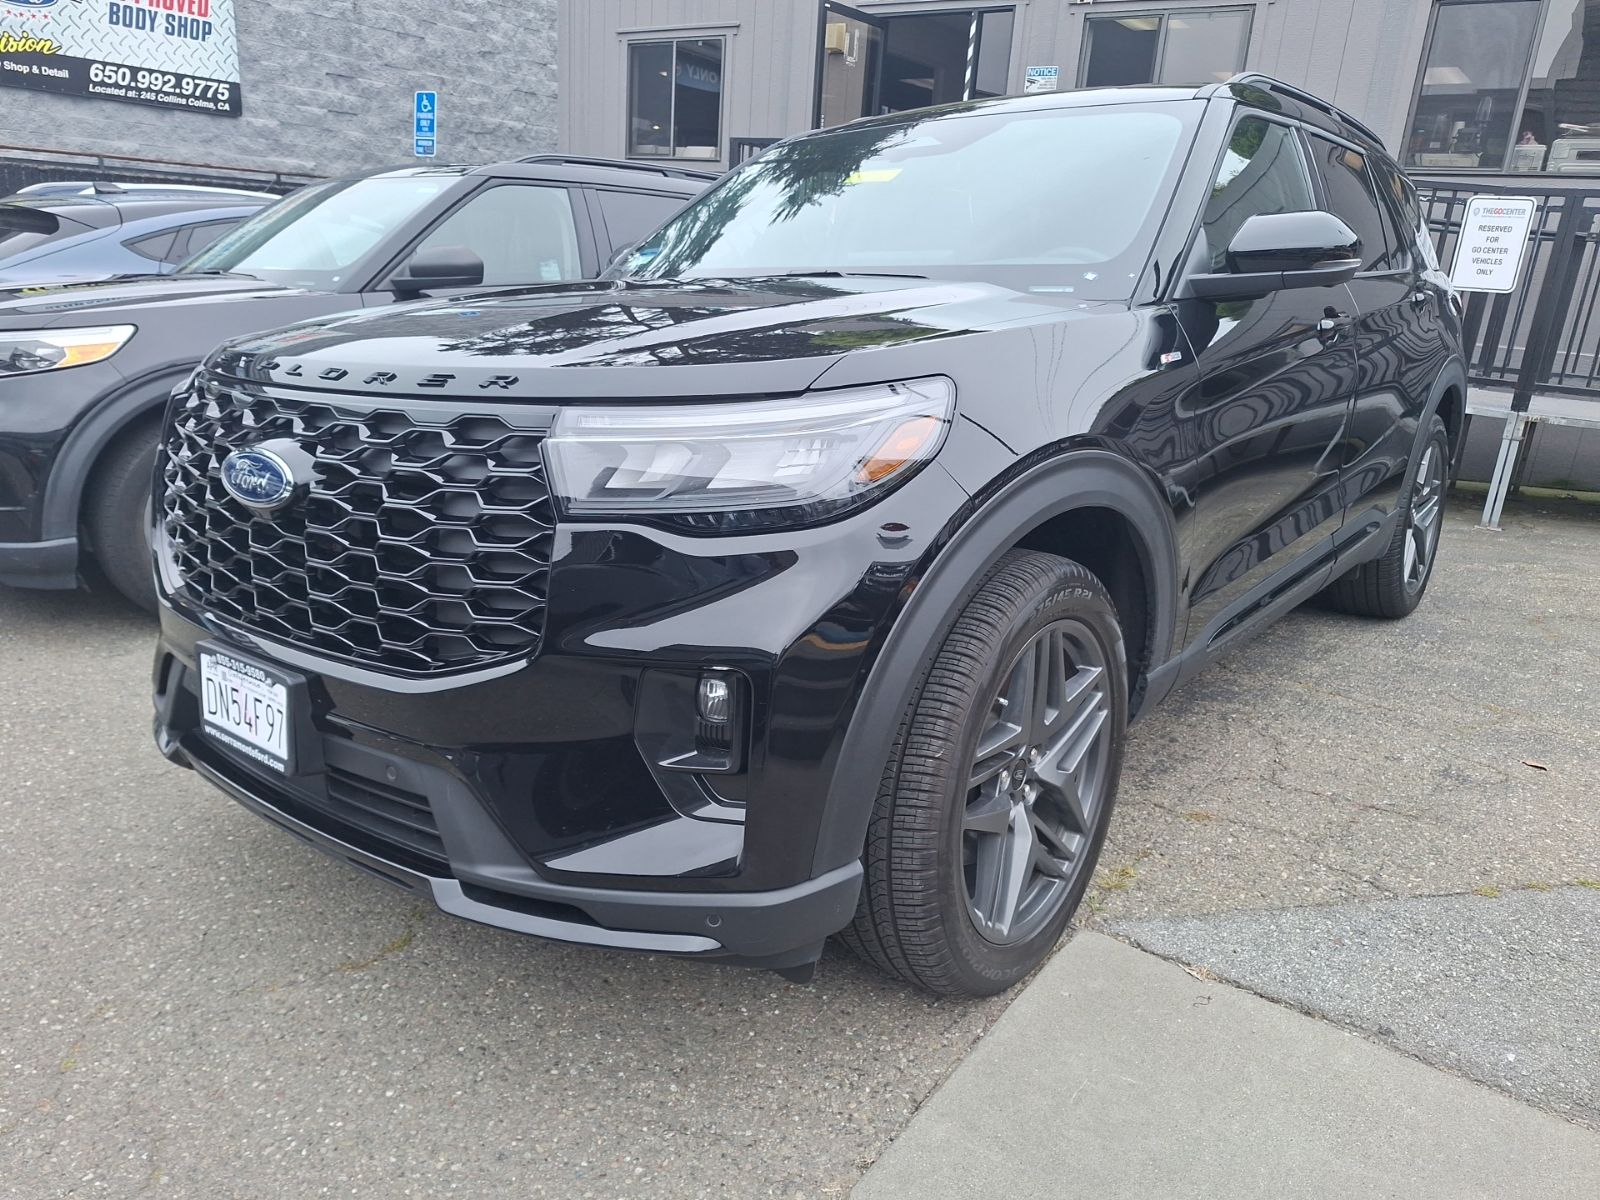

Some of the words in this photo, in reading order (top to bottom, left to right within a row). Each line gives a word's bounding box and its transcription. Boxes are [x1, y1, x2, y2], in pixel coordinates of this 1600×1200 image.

[109, 2, 158, 32] BODY
[165, 13, 212, 41] SHOP
[3, 61, 29, 74] Shop
[32, 65, 40, 74] &
[41, 66, 69, 78] Detail
[1028, 68, 1057, 76] NOTICE
[89, 63, 230, 101] 650.992.9775
[88, 84, 125, 97] Located
[126, 90, 139, 98] at:
[140, 91, 156, 101] 245
[157, 93, 187, 105] Collins
[188, 98, 216, 110] Colma,
[217, 102, 230, 111] CA
[1478, 225, 1512, 233] RESERVED
[1471, 246, 1481, 254] GO
[1472, 258, 1503, 266] VEHICLES
[230, 459, 270, 495] Ford
[1074, 588, 1093, 600] R21
[206, 677, 283, 750] DN54F97
